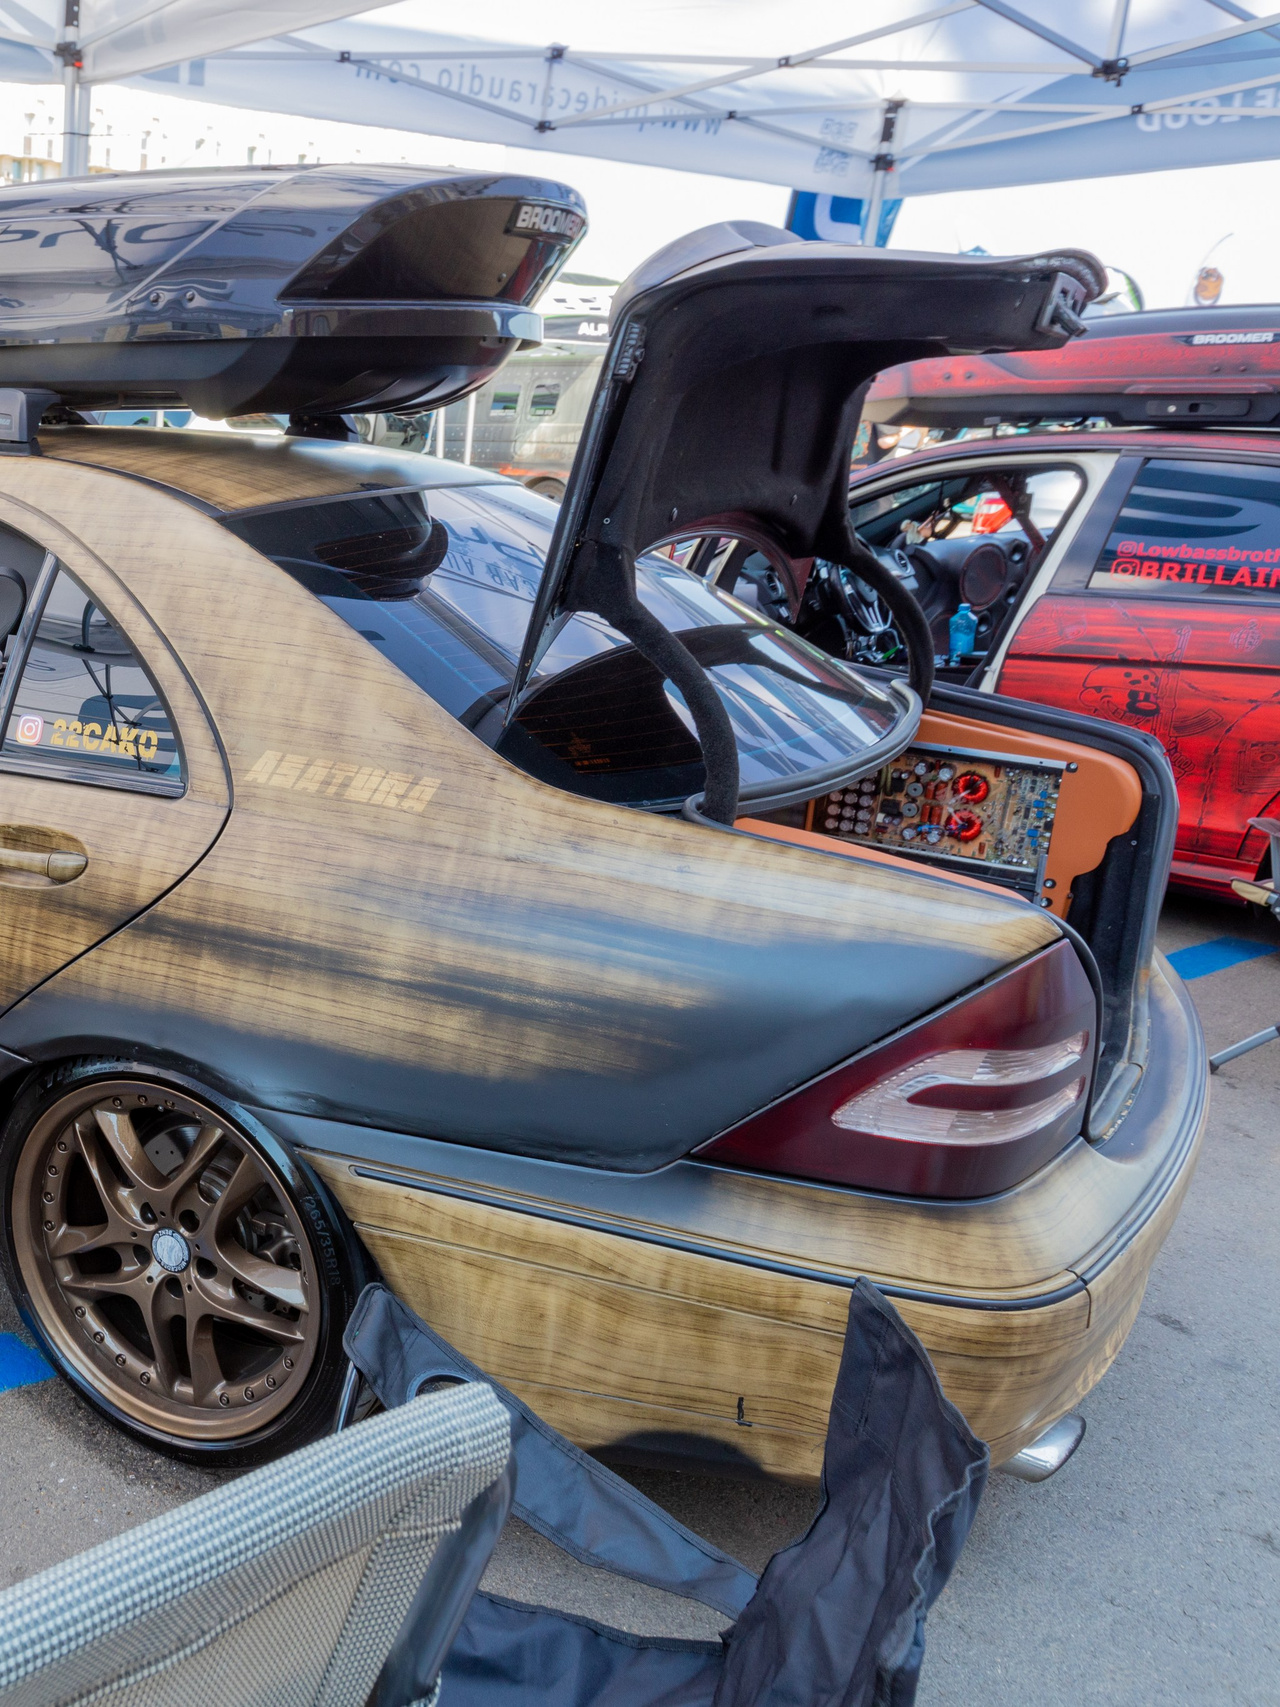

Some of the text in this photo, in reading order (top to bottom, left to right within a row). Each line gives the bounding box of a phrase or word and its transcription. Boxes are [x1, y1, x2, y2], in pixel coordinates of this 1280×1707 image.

[1192, 332, 1274, 345] BROOMER
[243, 750, 443, 812] ASATURA
[305, 1198, 341, 1287] 265/35R18
